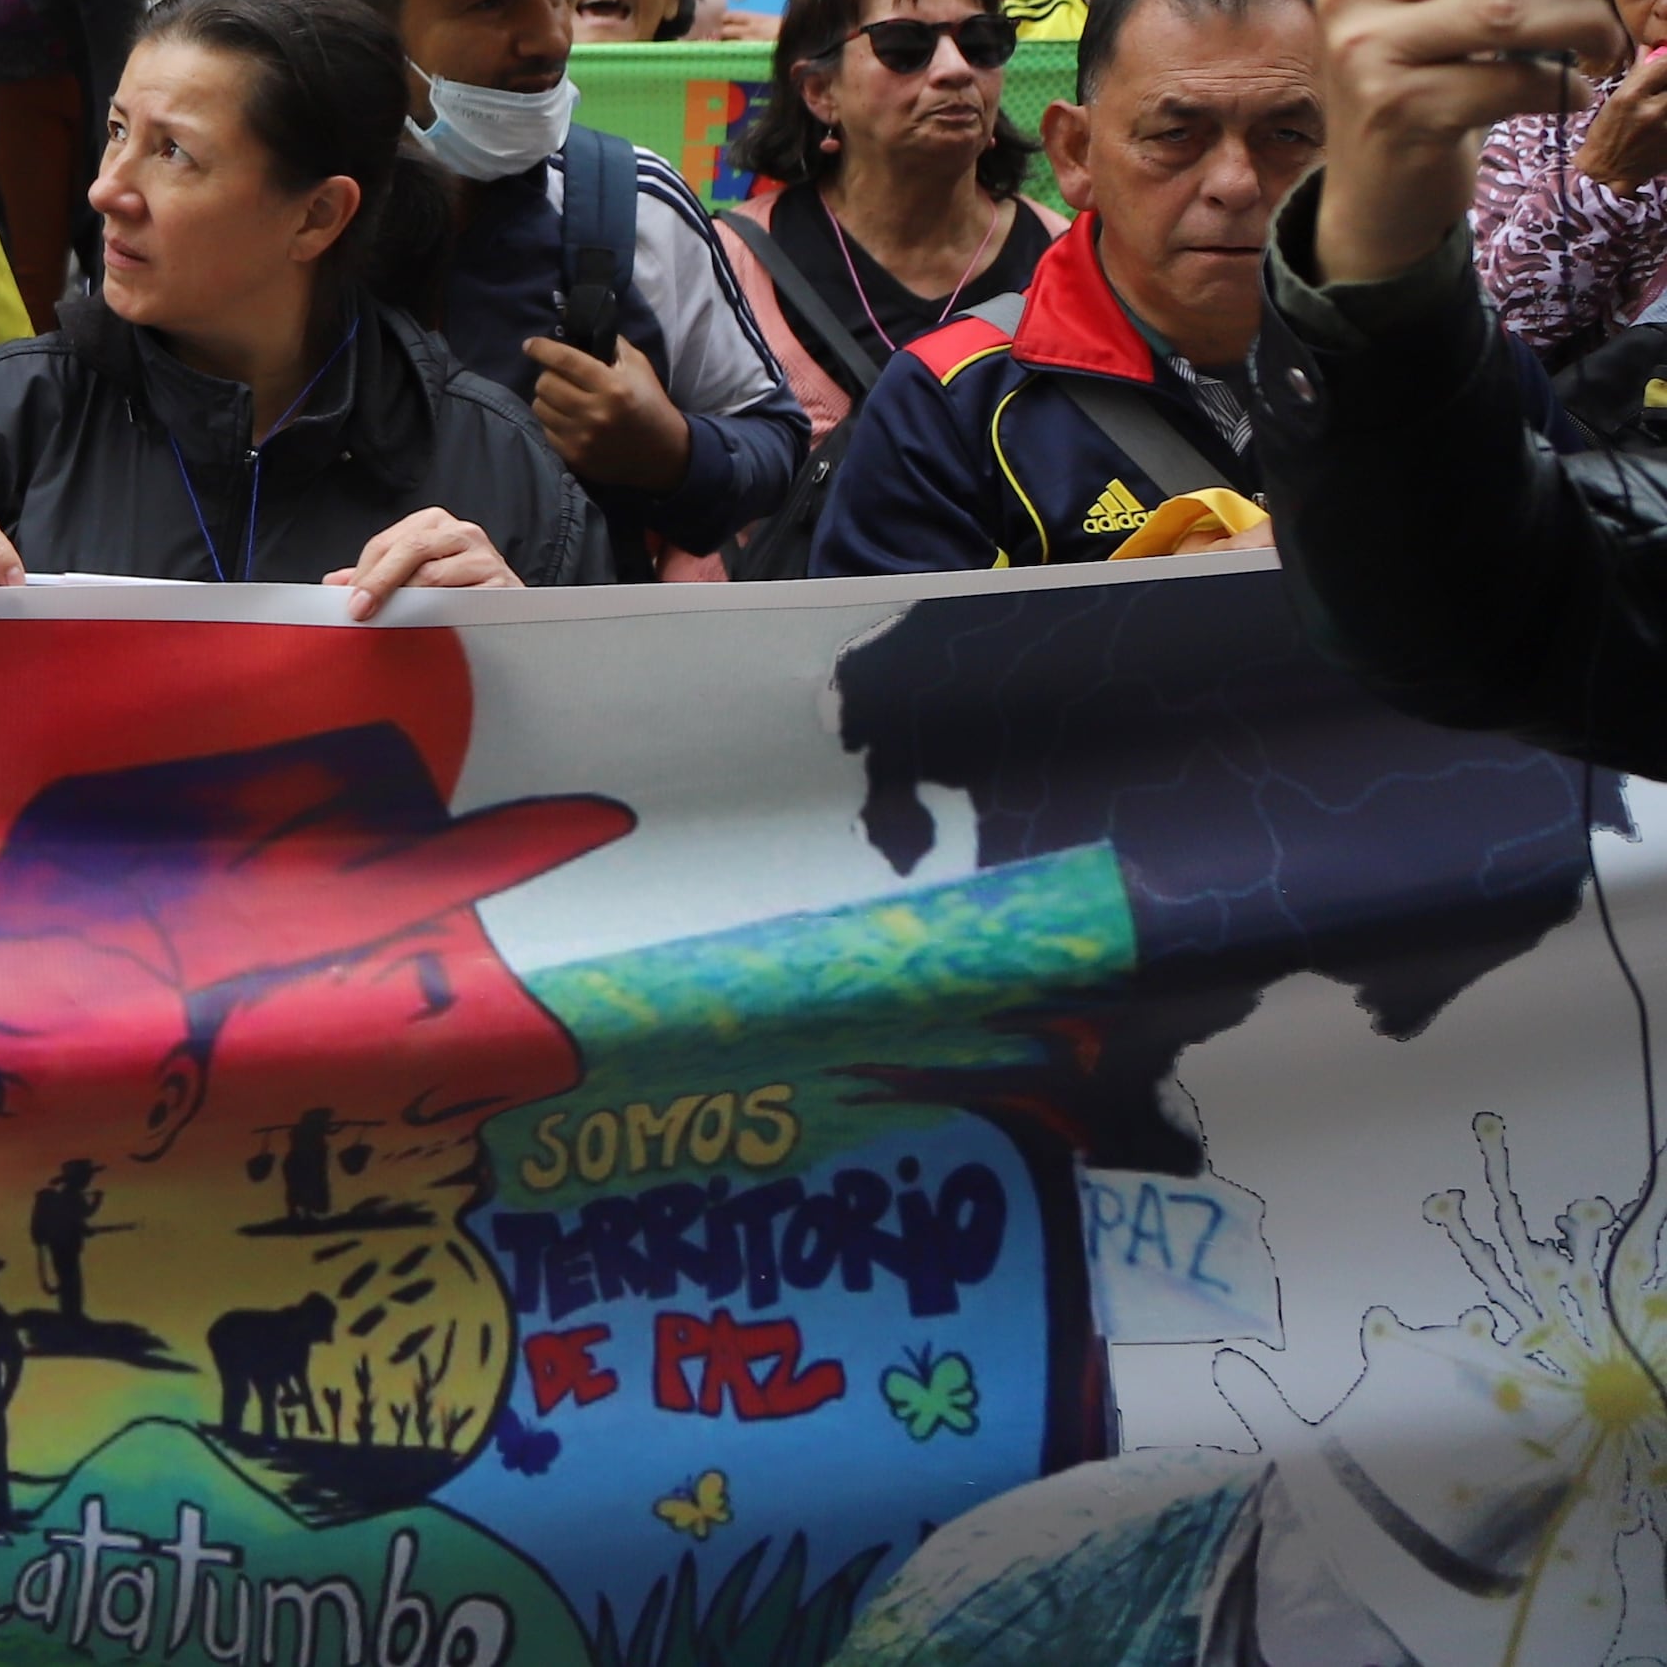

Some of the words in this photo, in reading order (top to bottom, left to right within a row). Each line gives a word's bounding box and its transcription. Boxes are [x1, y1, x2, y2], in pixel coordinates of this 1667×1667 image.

[520, 1083, 799, 1194] SOMOS
[1085, 1178, 1234, 1296] PAZ
[523, 1320, 620, 1417] DE
[653, 1309, 846, 1422] PAZ
